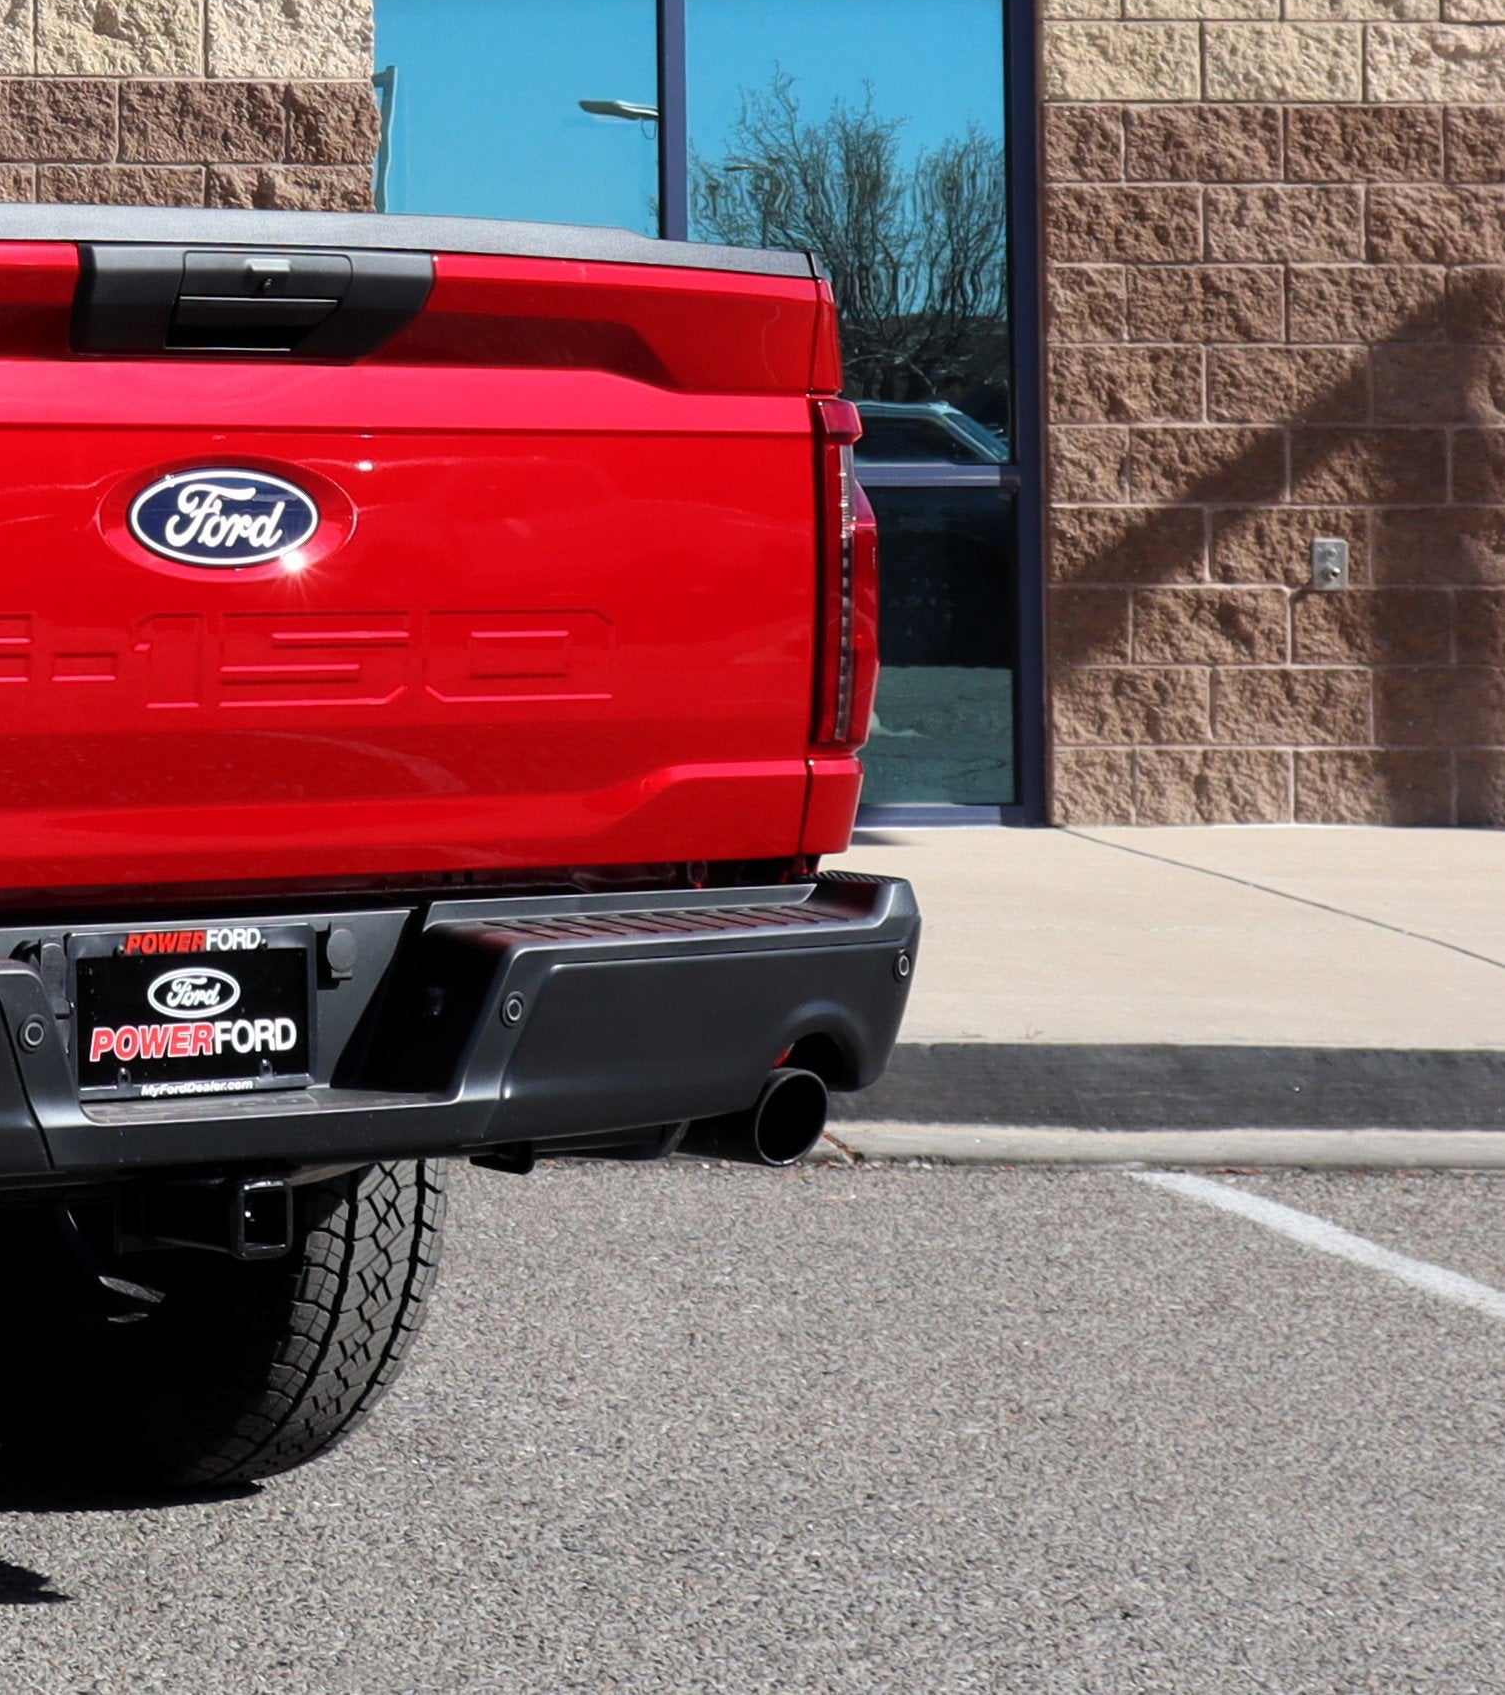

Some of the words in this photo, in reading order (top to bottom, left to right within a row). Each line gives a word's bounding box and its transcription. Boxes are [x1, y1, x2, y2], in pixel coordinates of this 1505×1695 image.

[165, 484, 284, 552] Ford
[124, 927, 262, 956] POWERFORD
[166, 975, 222, 1008] Ford
[89, 1017, 298, 1063] POWERFORD
[140, 1079, 254, 1097] MyFordDealer.com
